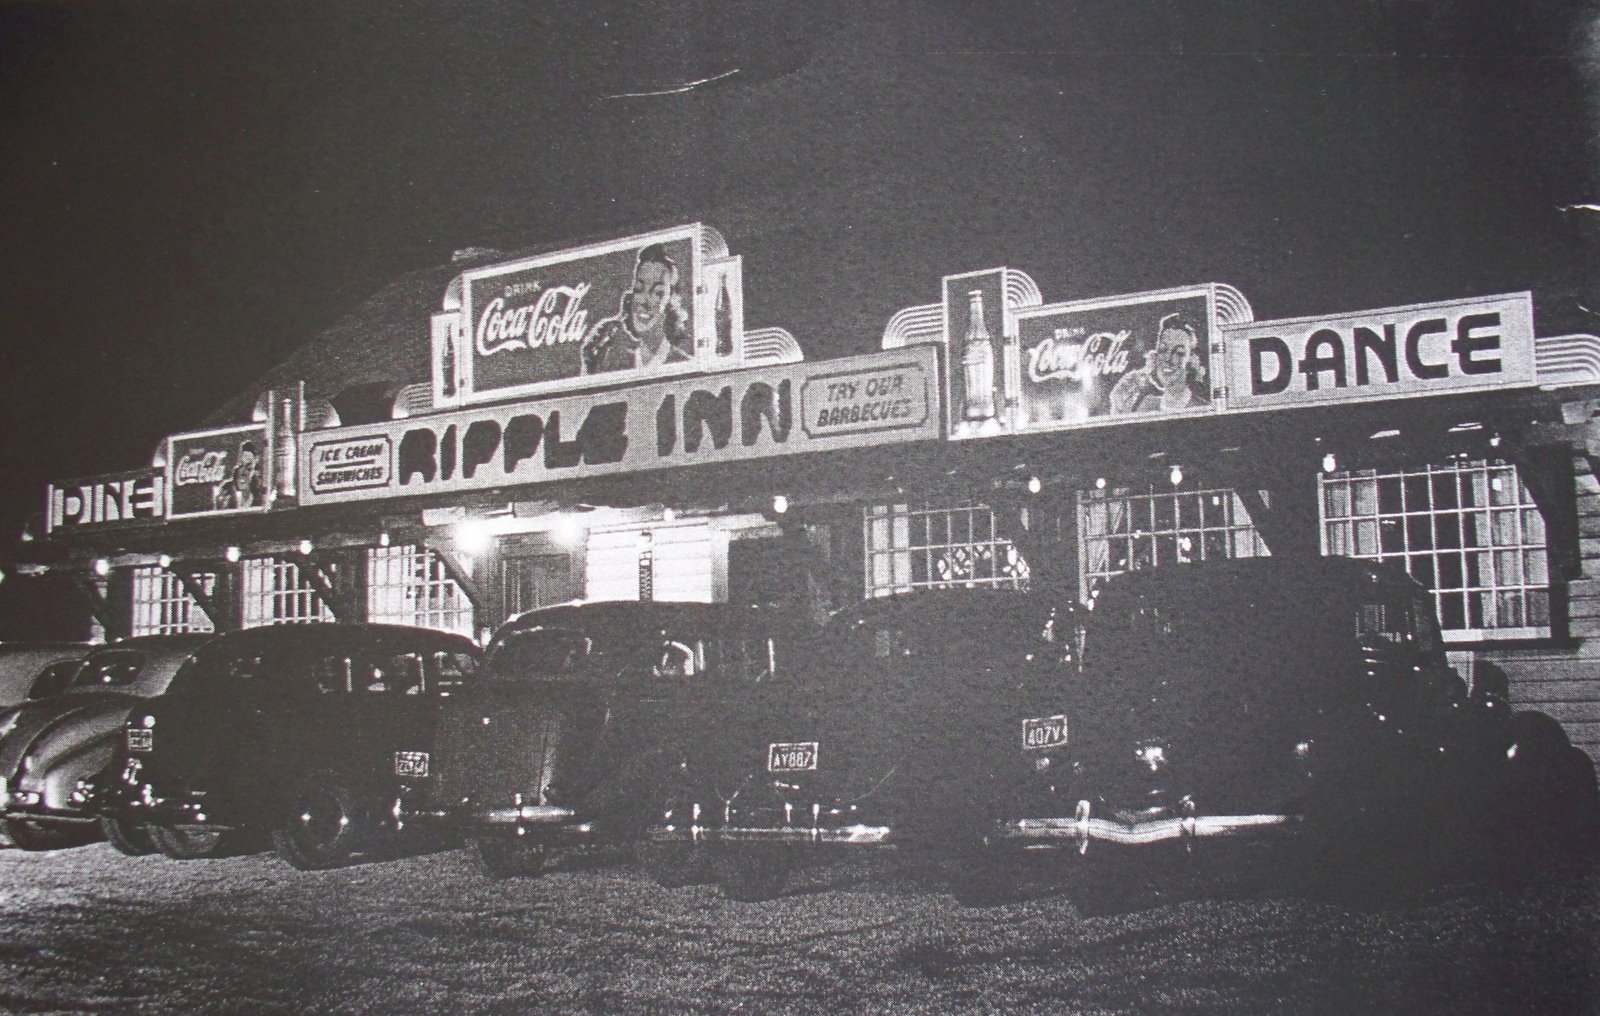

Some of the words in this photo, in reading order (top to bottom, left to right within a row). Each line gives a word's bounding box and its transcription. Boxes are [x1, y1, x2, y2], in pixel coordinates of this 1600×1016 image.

[503, 280, 541, 297] DRINK
[1249, 311, 1503, 396] DANCE
[827, 381, 860, 401] TRY
[866, 375, 903, 397] OUR
[817, 399, 912, 427] BARBECUES
[399, 401, 629, 486] RIPPLE
[657, 378, 792, 457] INN
[320, 448, 341, 462] ICE
[345, 444, 384, 460] CREAM
[61, 478, 154, 526] DINE
